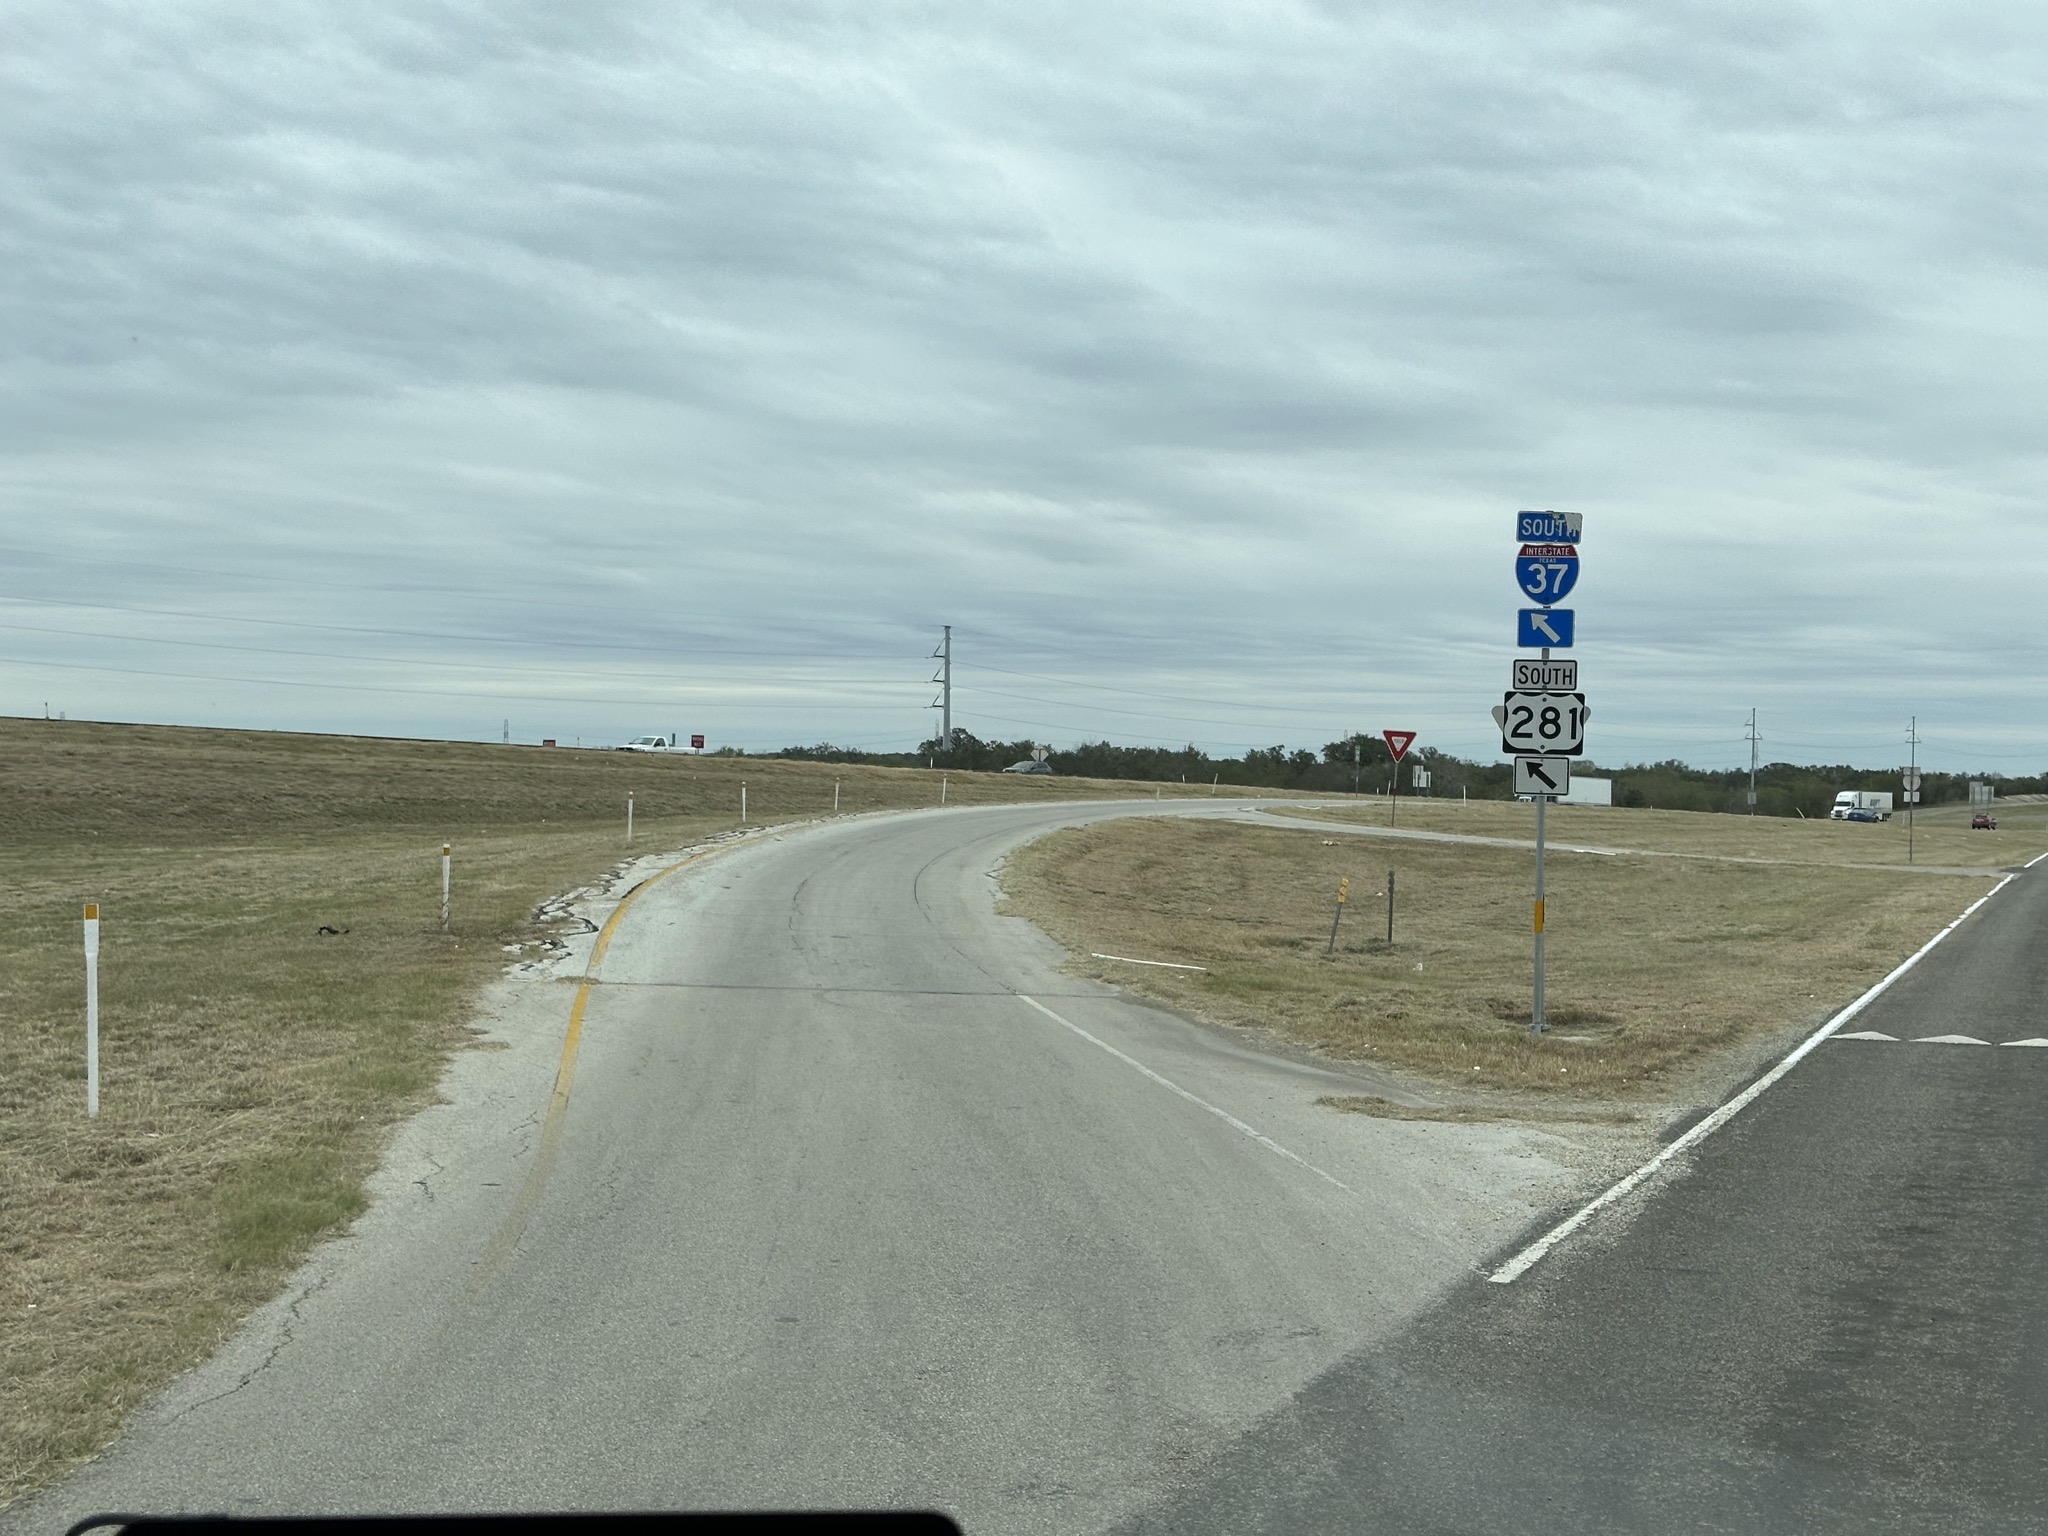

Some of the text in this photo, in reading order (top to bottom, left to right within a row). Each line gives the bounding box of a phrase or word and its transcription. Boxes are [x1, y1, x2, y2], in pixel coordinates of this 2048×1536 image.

[1526, 547, 1570, 556] INTERSTATE
[1526, 563, 1569, 594] 37
[1518, 665, 1573, 685] SOUTH
[1510, 705, 1578, 740] 281
